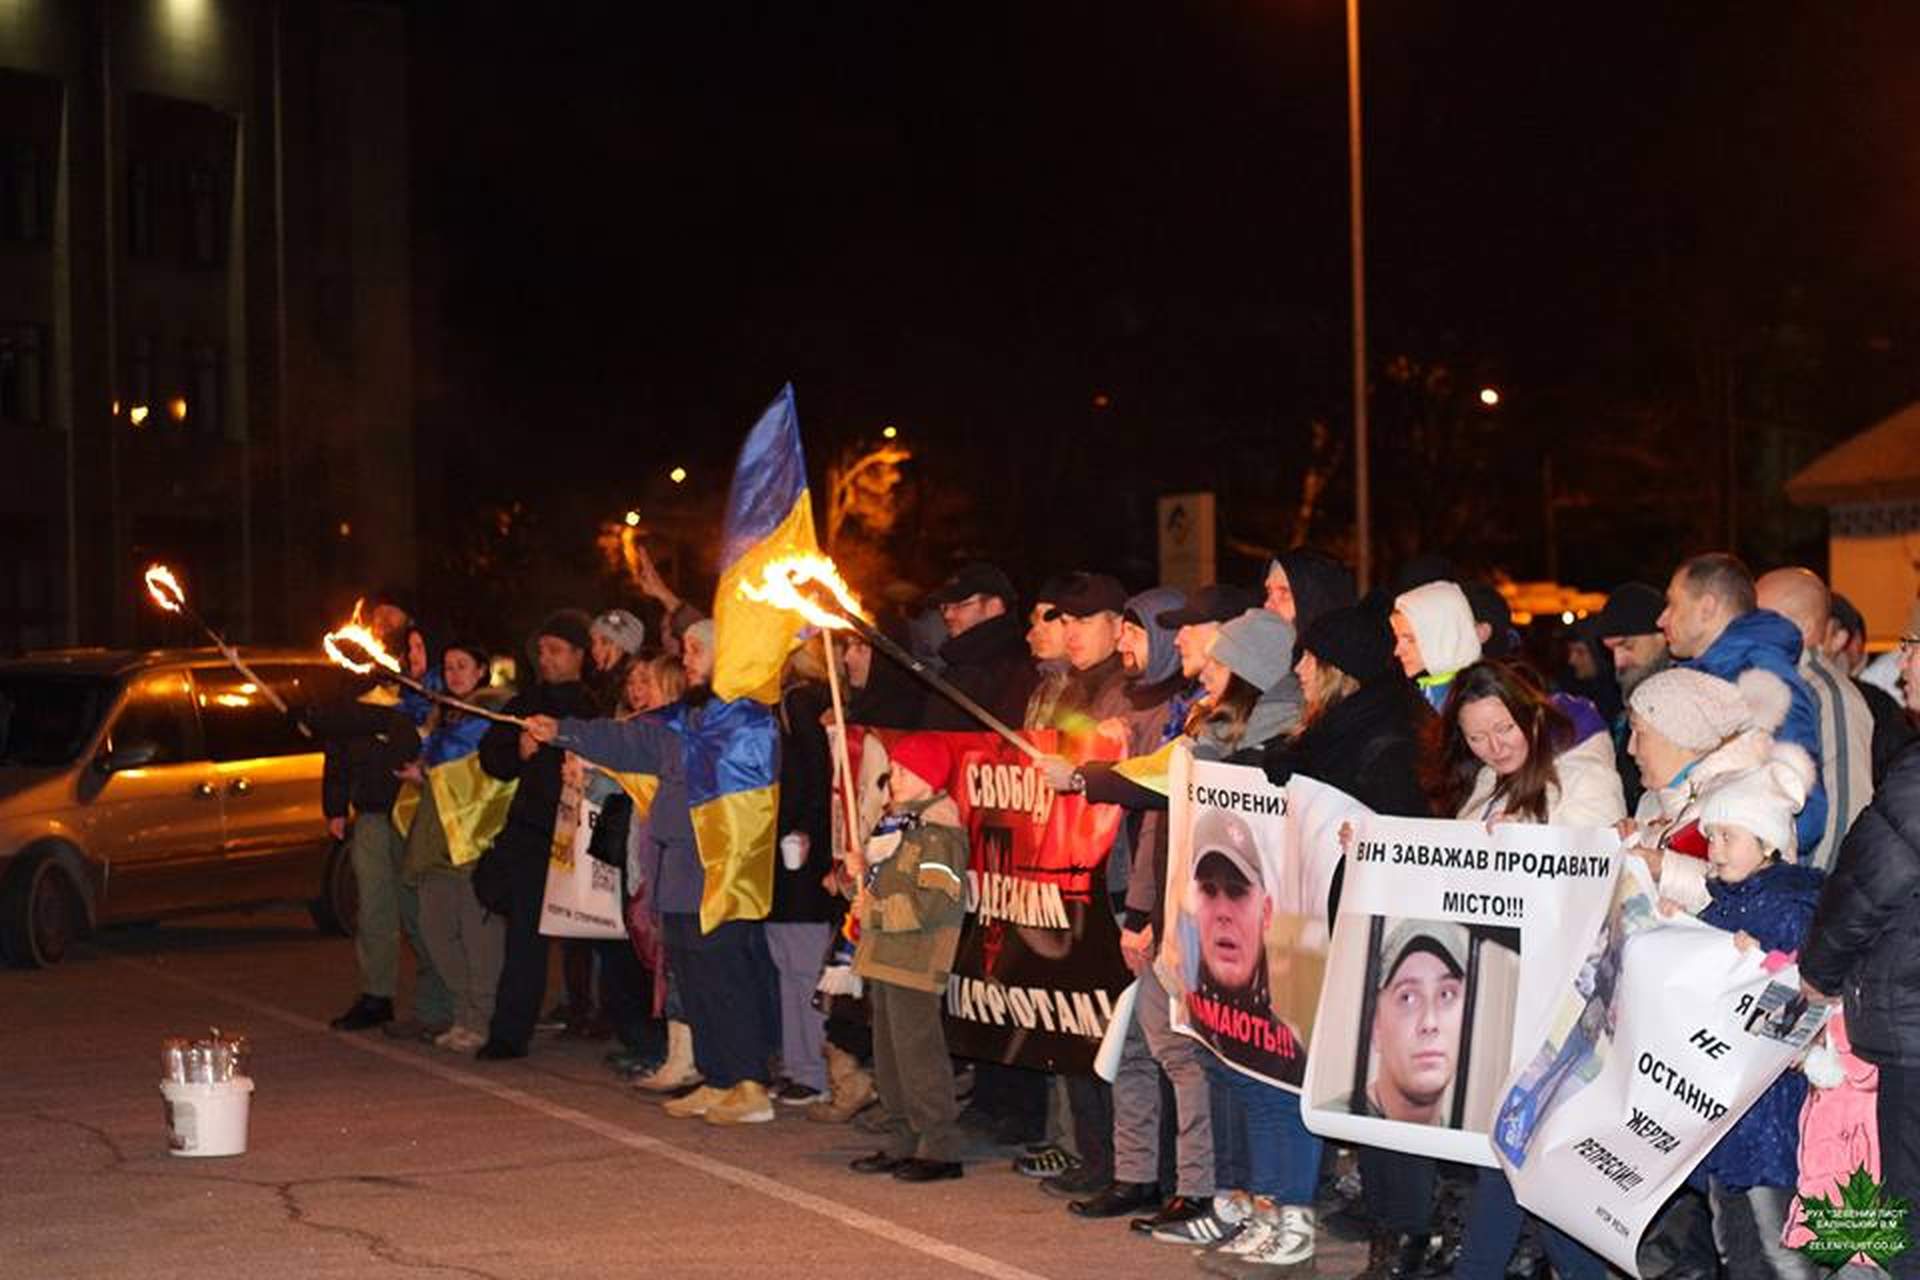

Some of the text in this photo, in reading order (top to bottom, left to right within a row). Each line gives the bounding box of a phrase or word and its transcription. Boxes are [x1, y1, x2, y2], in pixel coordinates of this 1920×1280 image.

[1197, 785, 1289, 816] СКОРЕНИХ
[1356, 842, 1610, 879] ВІН ЗАВАЖАВ ПРОДАВАТИ
[1442, 891, 1524, 918] МІСТО!!!
[1734, 993, 1754, 1016] Я
[1689, 1028, 1732, 1060] НЕ
[1638, 1052, 1729, 1122] ОСТАННЯ
[1626, 1107, 1681, 1154] ЖЕРТВА
